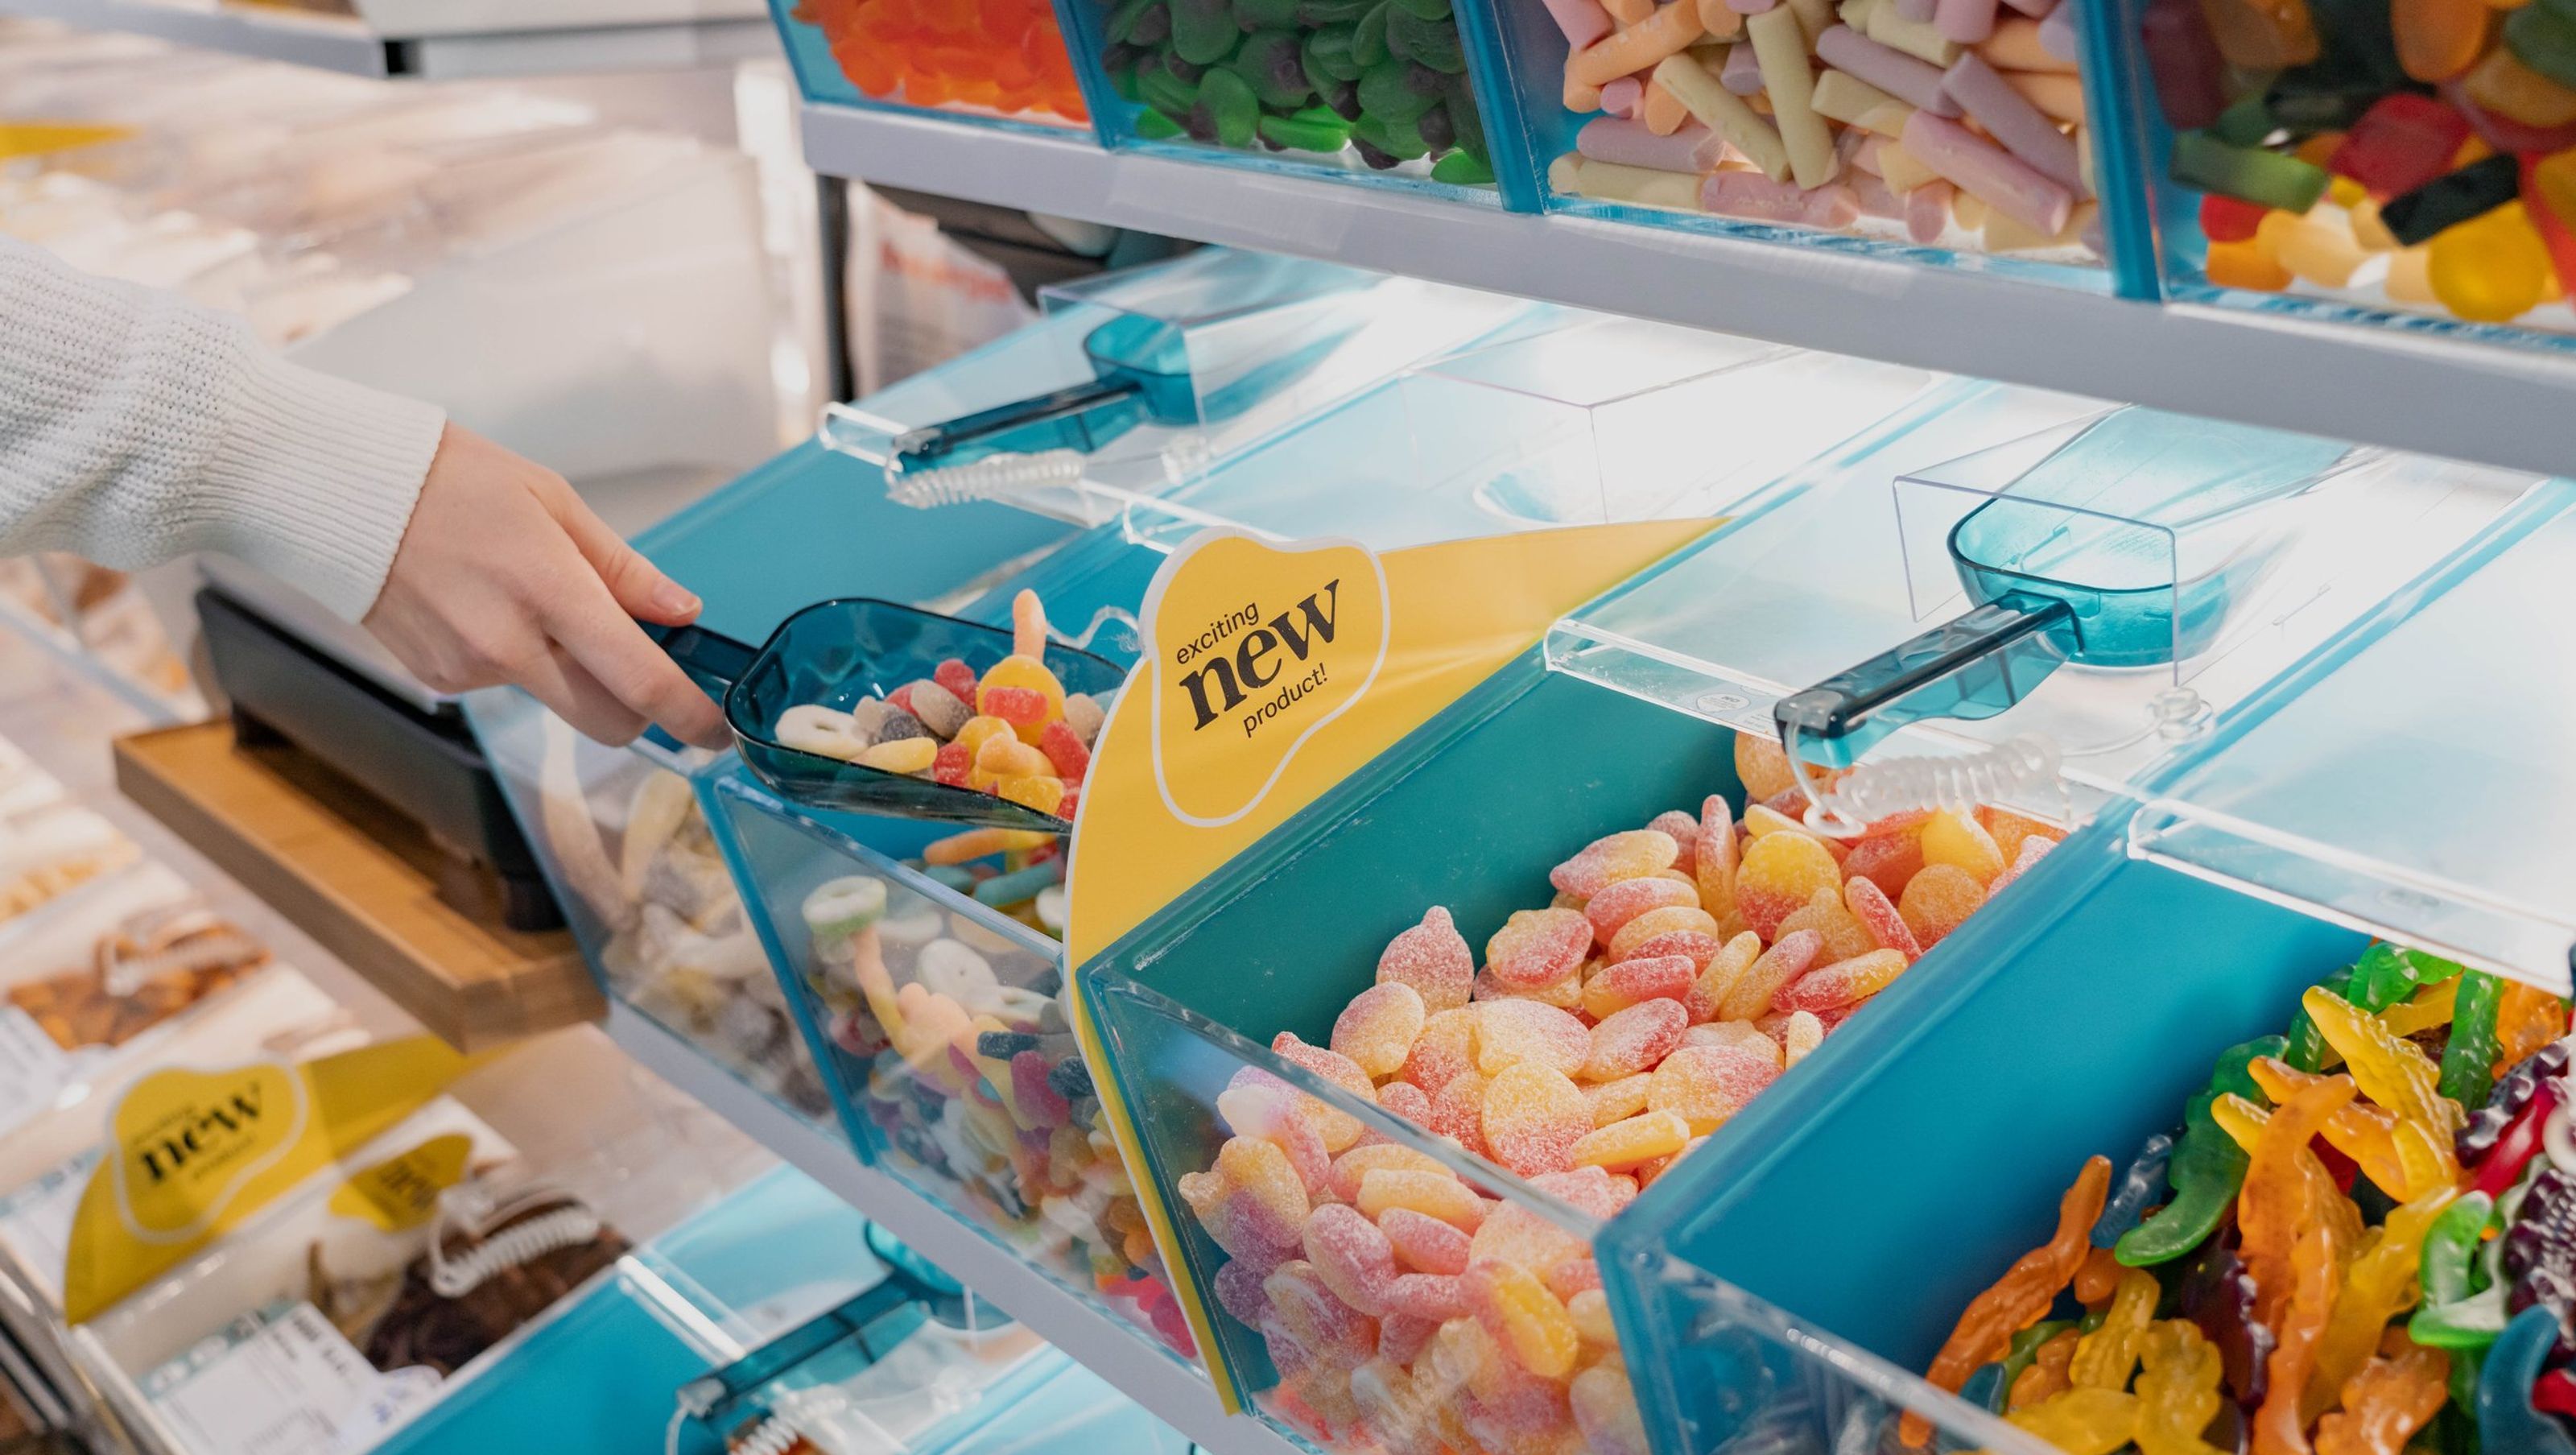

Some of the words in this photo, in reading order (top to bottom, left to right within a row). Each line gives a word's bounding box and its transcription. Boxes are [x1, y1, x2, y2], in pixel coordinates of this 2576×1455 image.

[1176, 602, 1258, 665] exciting
[1179, 578, 1340, 731] new
[1243, 663, 1328, 738] product!
[139, 1081, 262, 1184] new
